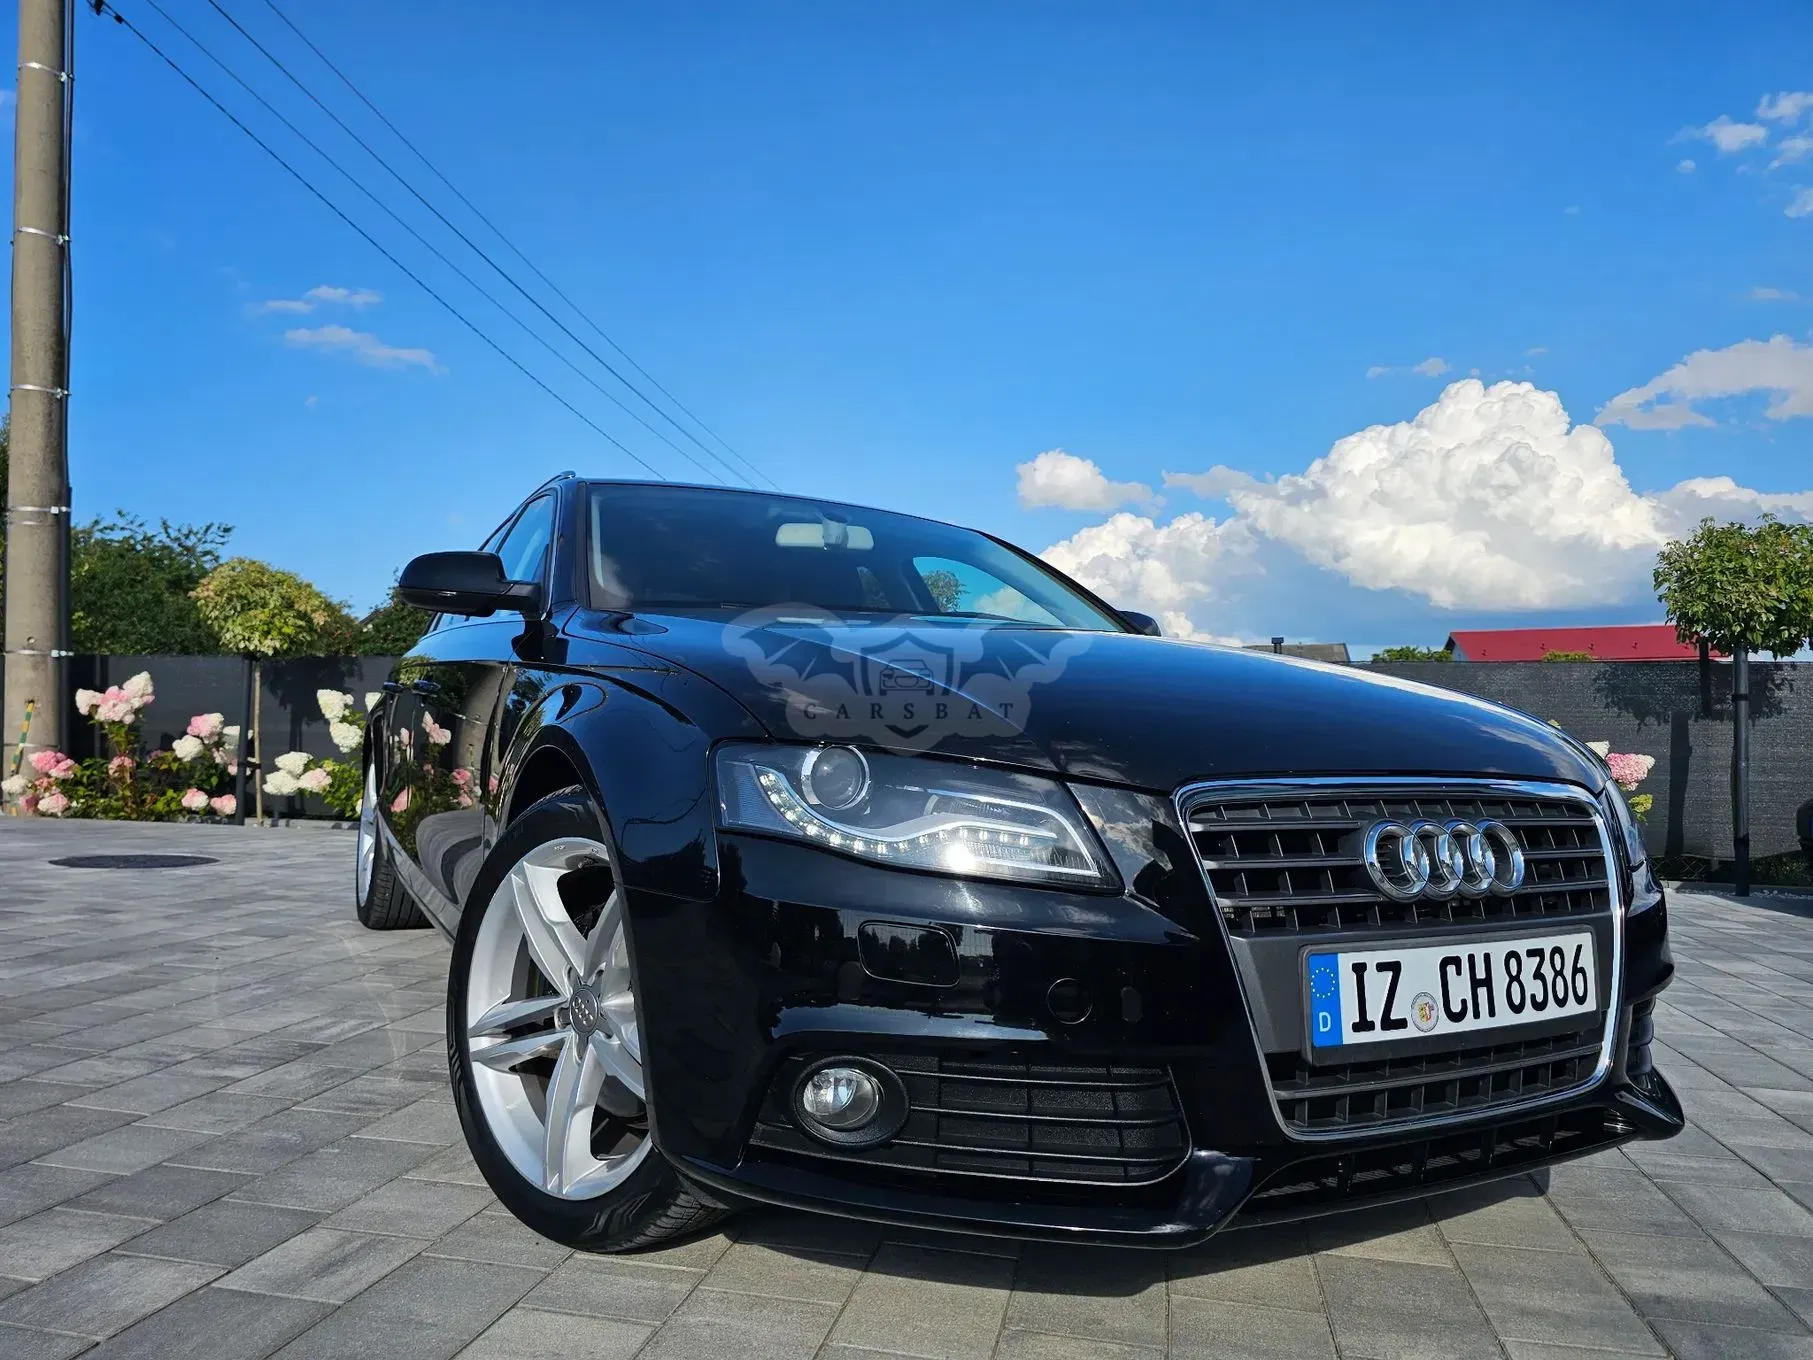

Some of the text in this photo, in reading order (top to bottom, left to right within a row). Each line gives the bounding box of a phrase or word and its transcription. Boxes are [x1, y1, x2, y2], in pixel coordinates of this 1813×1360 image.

[1351, 944, 1588, 1033] IZ CH 8386
[1319, 1012, 1331, 1032] D
